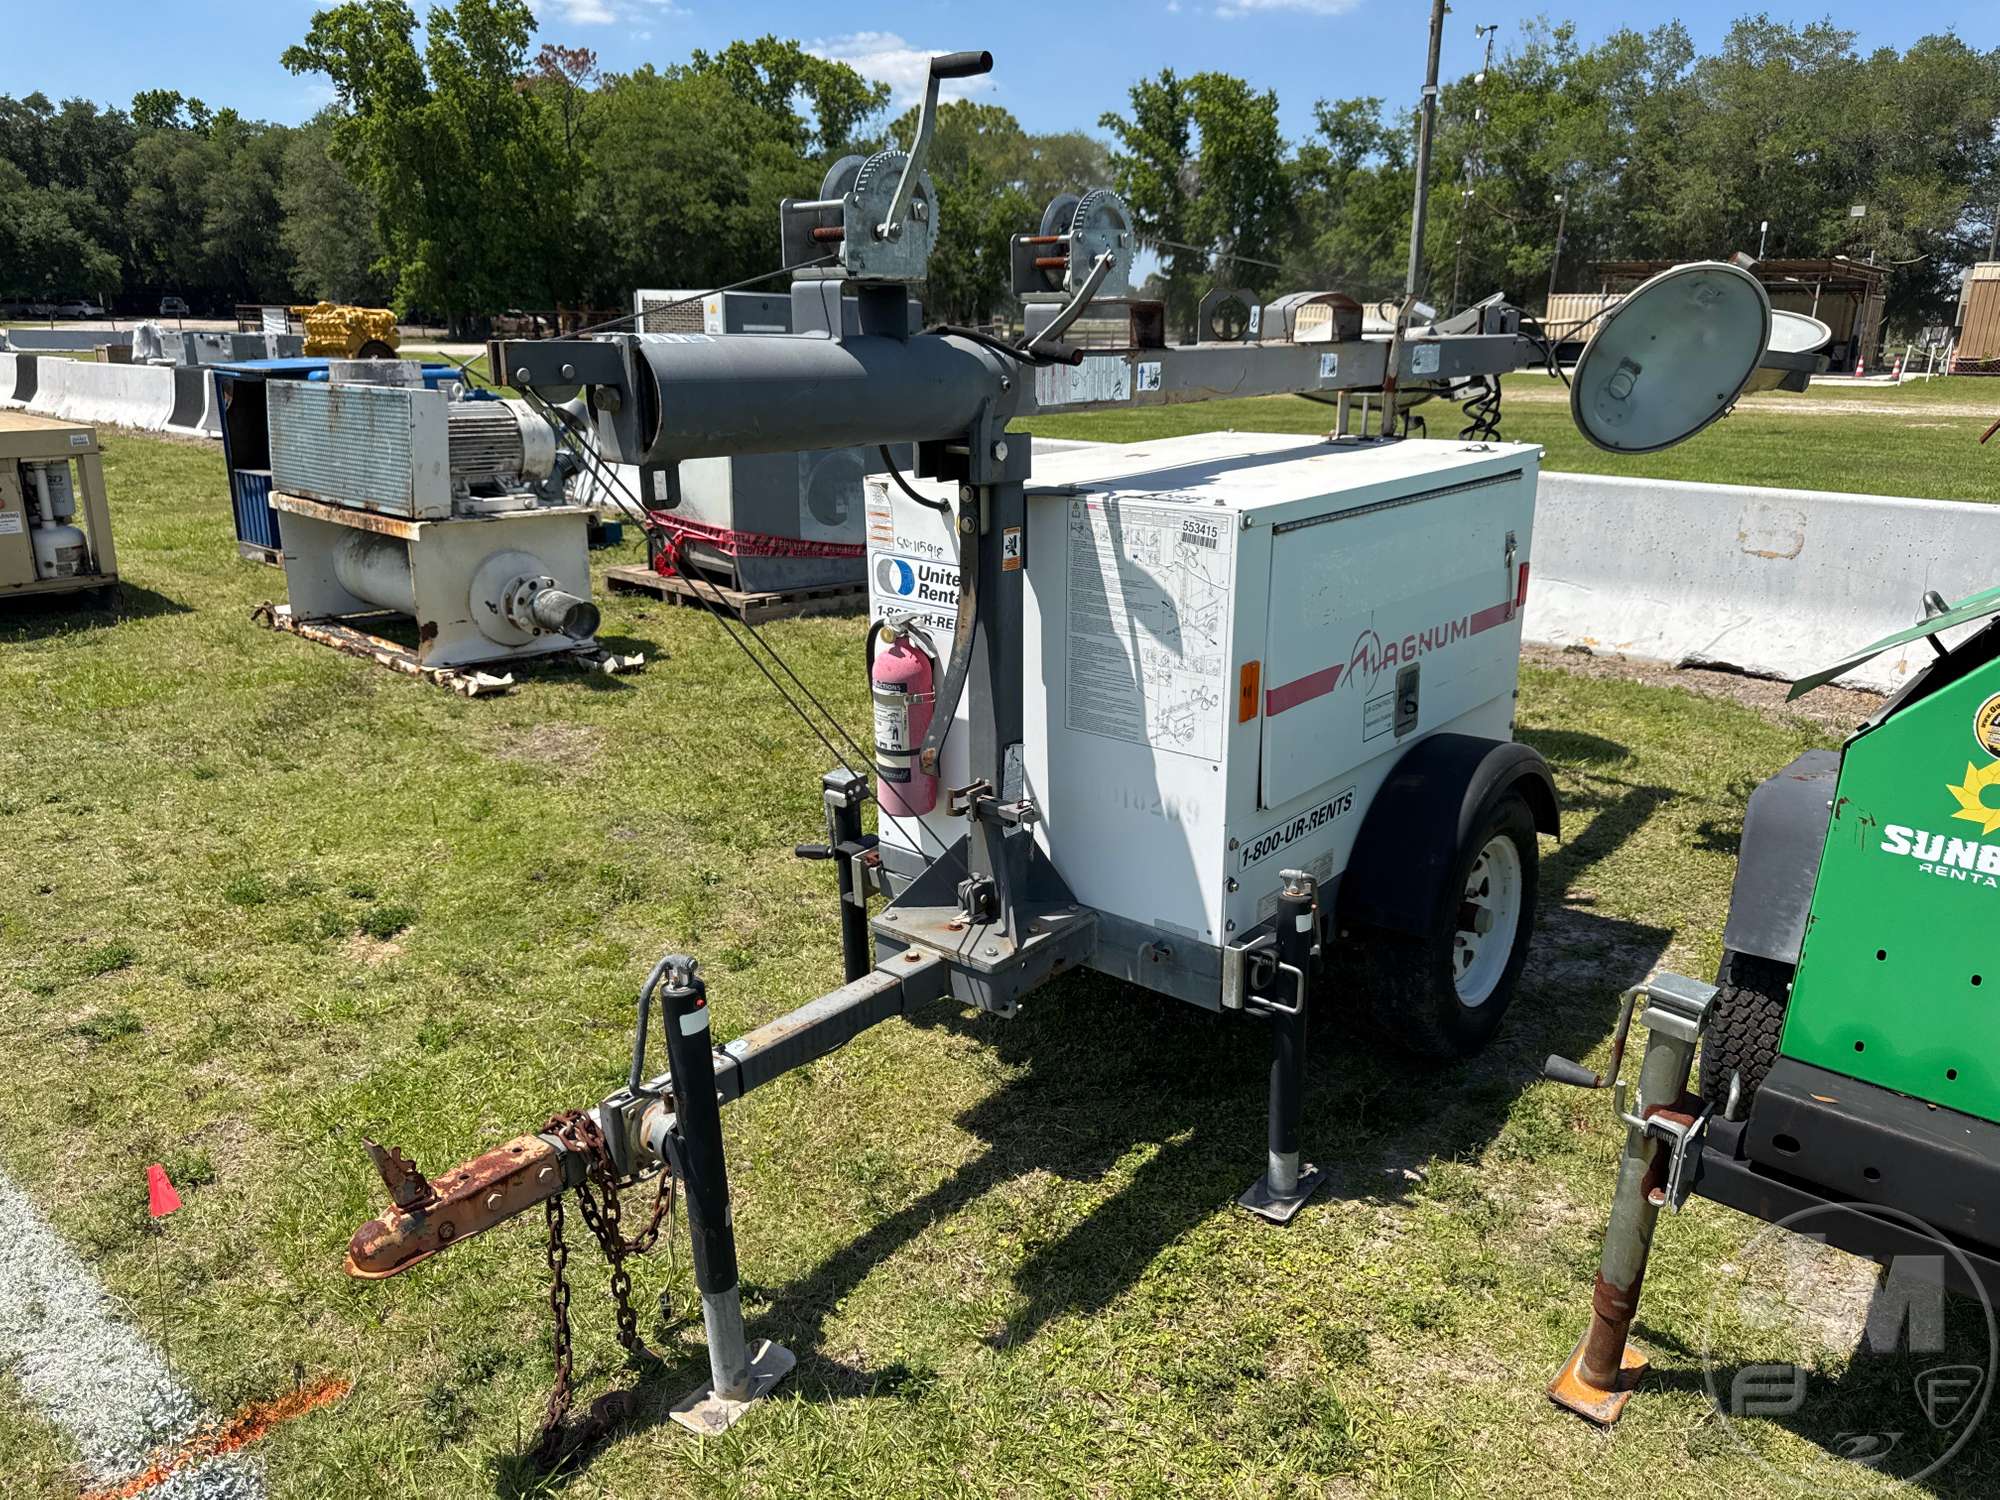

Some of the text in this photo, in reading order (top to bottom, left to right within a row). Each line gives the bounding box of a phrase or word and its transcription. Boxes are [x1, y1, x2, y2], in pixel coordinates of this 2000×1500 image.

[1182, 520, 1218, 538] 553415
[1341, 616, 1468, 688] MAGNUM
[1242, 791, 1353, 868] 1-800-UR-RENTS
[1919, 863, 1998, 889] RENTA
